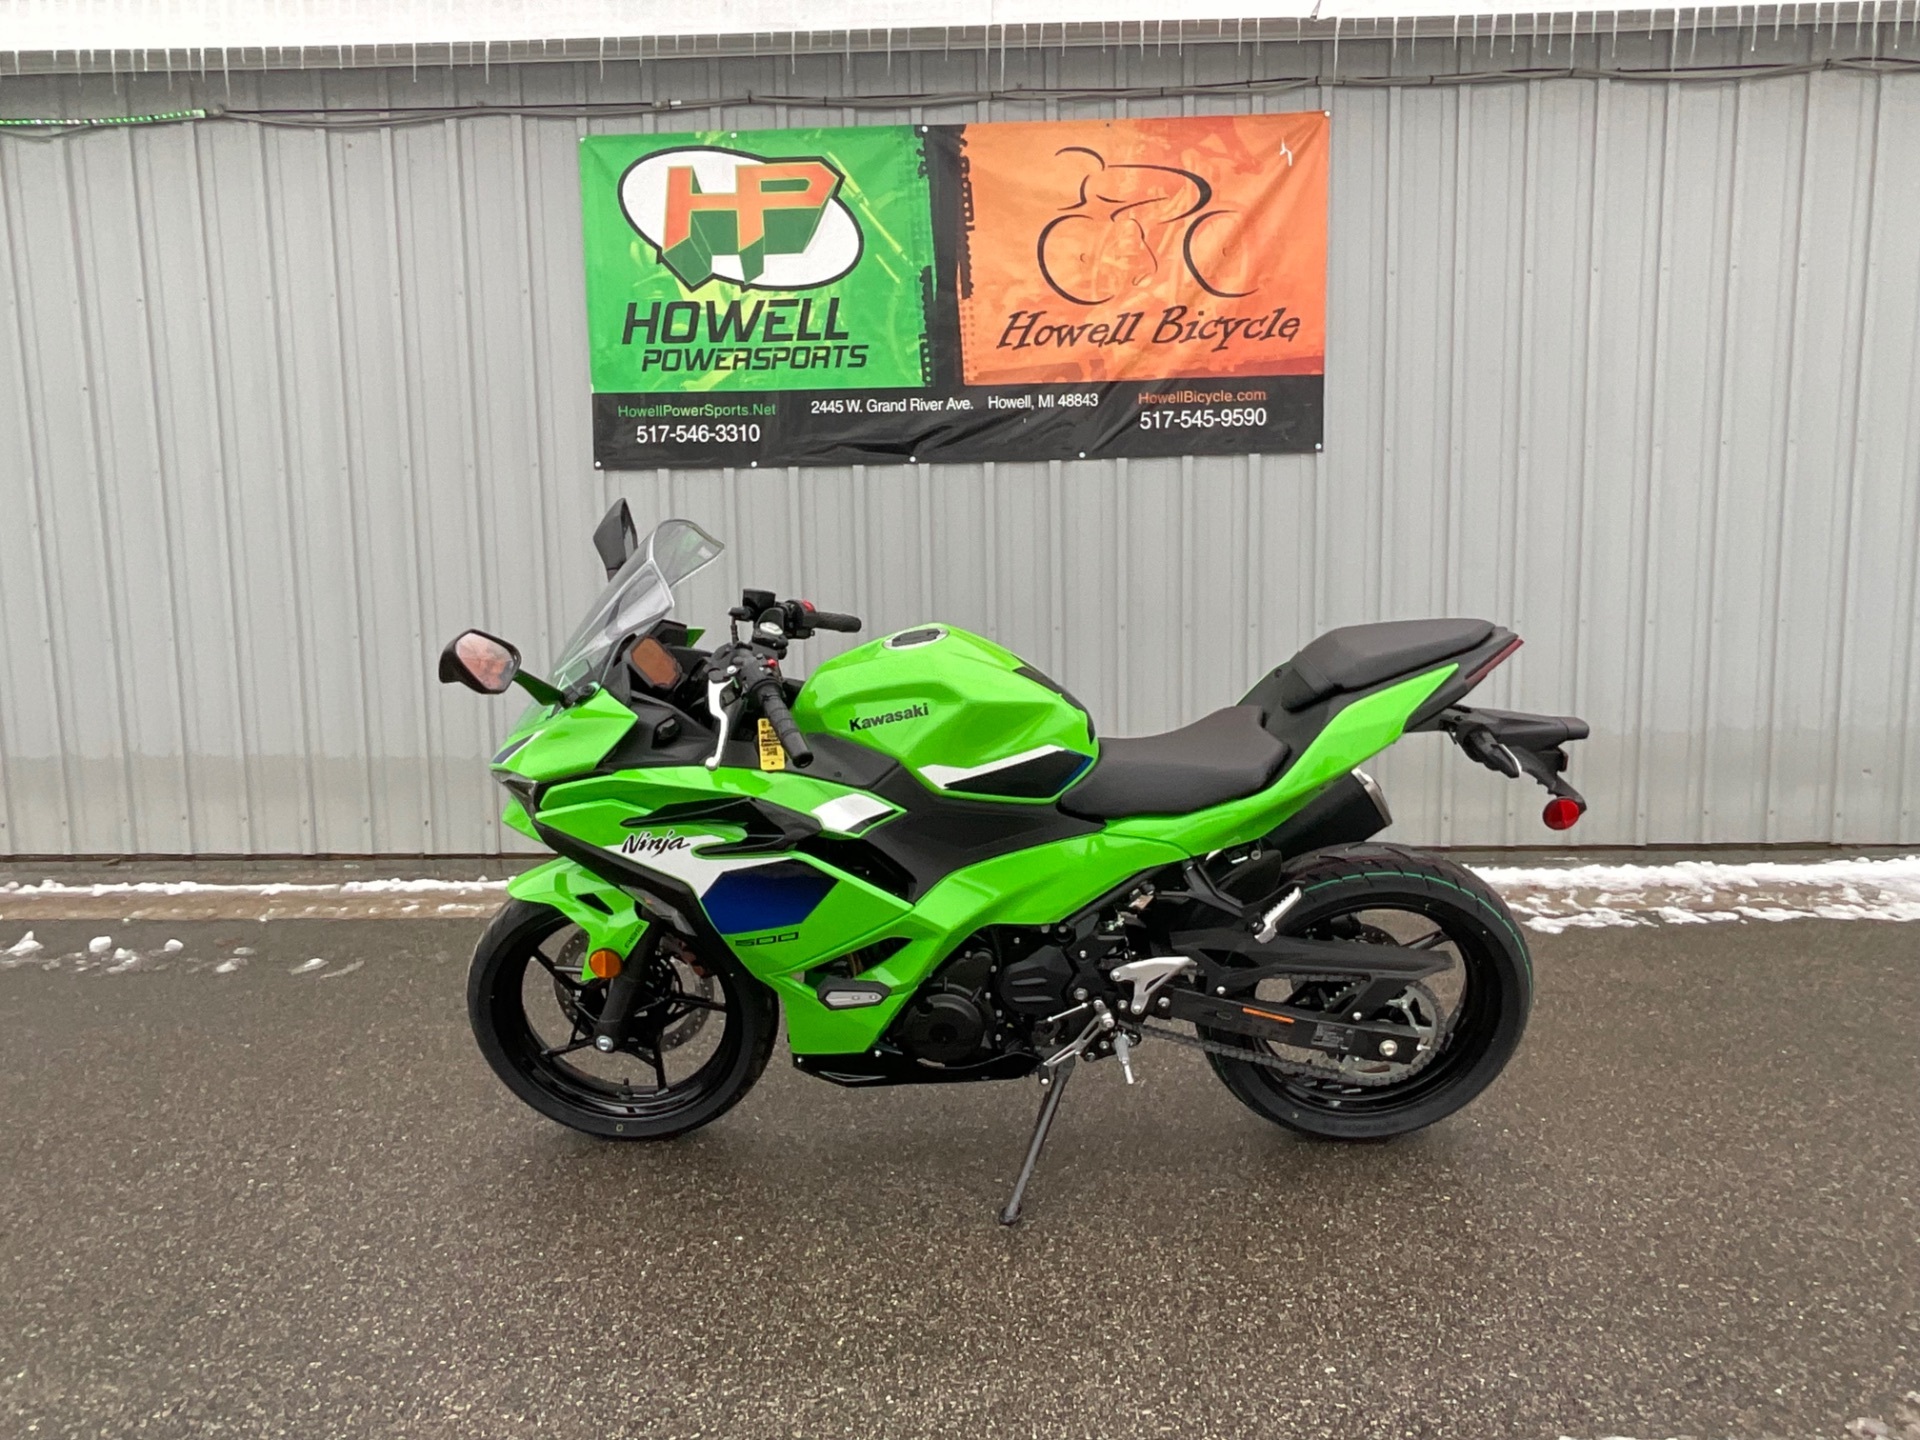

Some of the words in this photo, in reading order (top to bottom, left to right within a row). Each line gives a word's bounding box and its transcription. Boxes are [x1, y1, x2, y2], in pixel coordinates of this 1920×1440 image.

[621, 297, 849, 345] HOWELL
[996, 309, 1145, 351] Howell
[1150, 304, 1301, 353] Bicycle
[641, 345, 869, 372] POWERSPORTS
[810, 400, 844, 415] 2445
[845, 399, 863, 414] W.
[866, 398, 907, 414] Grand
[910, 397, 943, 412] River
[945, 397, 974, 411] Ave.
[988, 394, 1035, 411] Howell,
[1038, 392, 1055, 408] MI
[1057, 393, 1099, 408] 48843
[1138, 388, 1267, 405] HowellBicycle.com
[617, 403, 777, 418] HowellPowerSports.Net
[1139, 407, 1268, 430] 517-545-9590
[635, 423, 761, 444] 517-546-3310
[849, 702, 930, 732] Kawasaki
[621, 829, 691, 857] Ninja
[735, 931, 800, 948] 500
